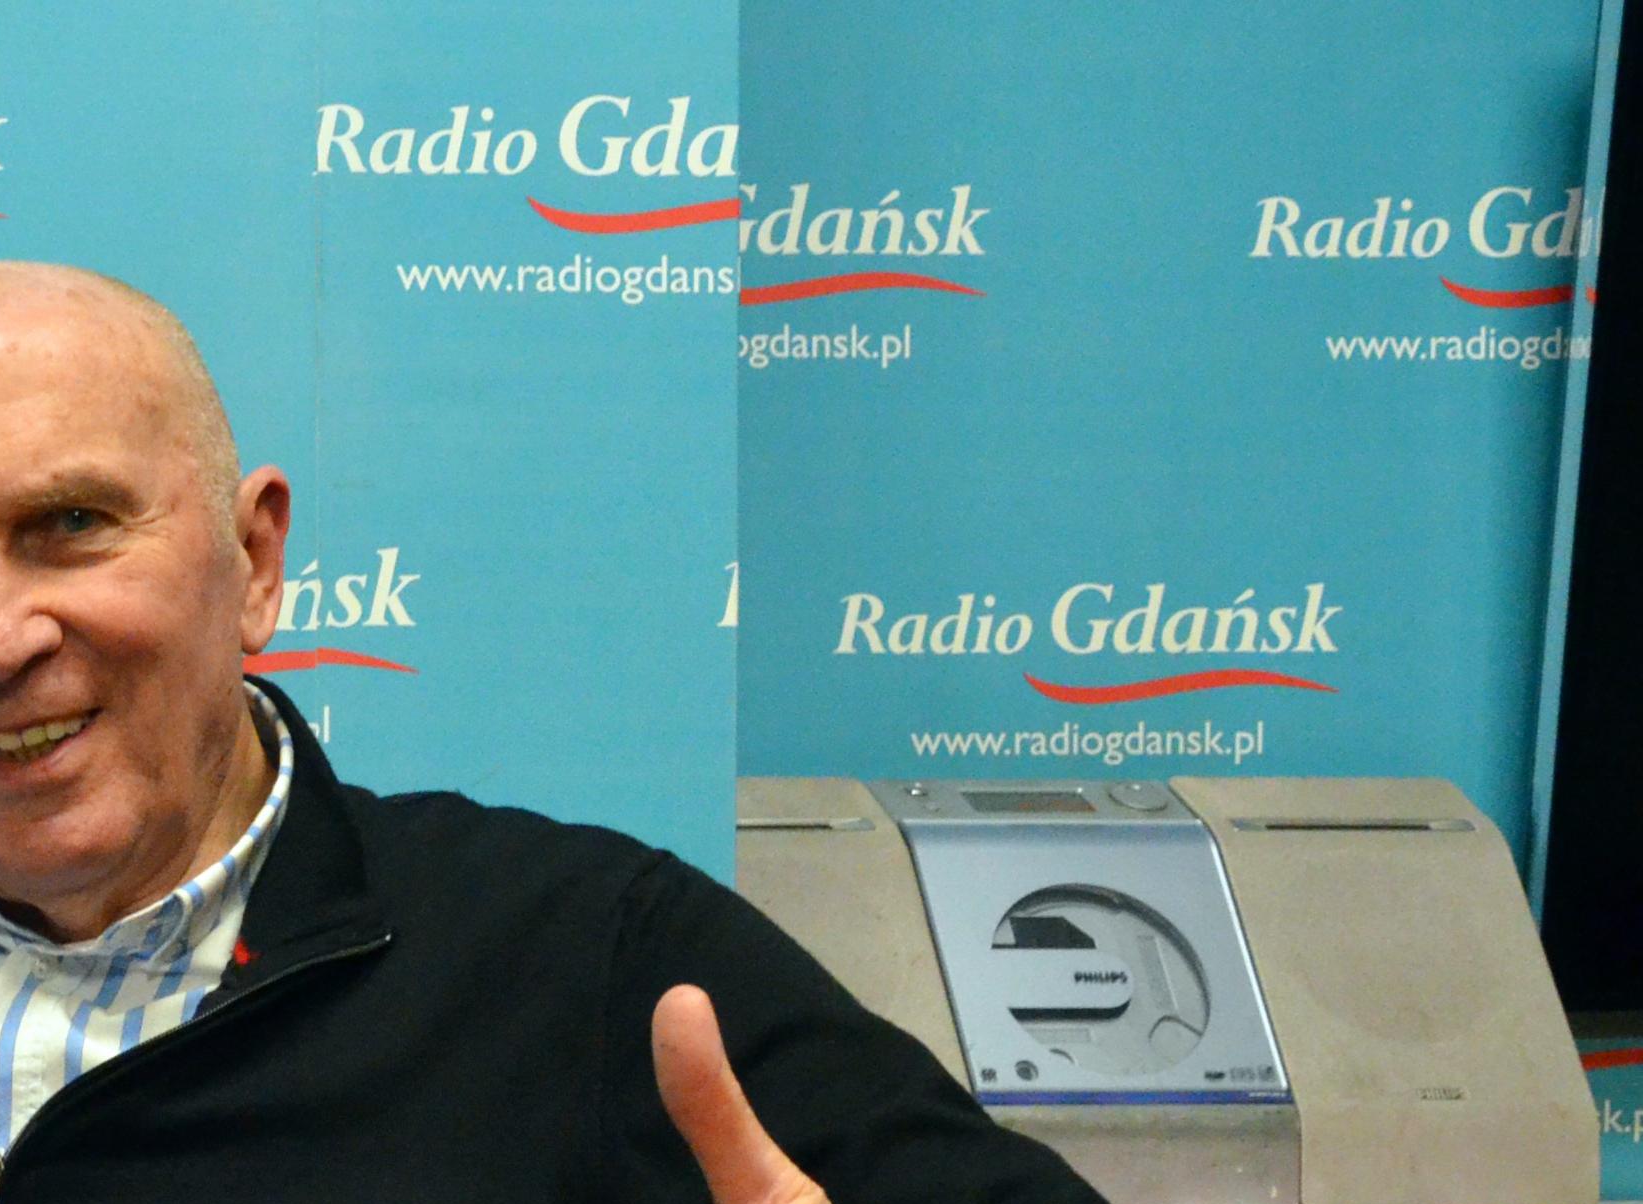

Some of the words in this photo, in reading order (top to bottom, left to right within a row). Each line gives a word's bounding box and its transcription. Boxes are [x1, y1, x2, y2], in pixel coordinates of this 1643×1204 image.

[313, 104, 537, 175] Radio
[559, 95, 738, 177] Gda
[1251, 197, 1450, 258] Radio
[397, 255, 740, 305] www.radiogdans
[835, 593, 1033, 654] Radio
[1051, 583, 1342, 654] Gdańsk
[911, 720, 1264, 765] www.radiogdansk.pl
